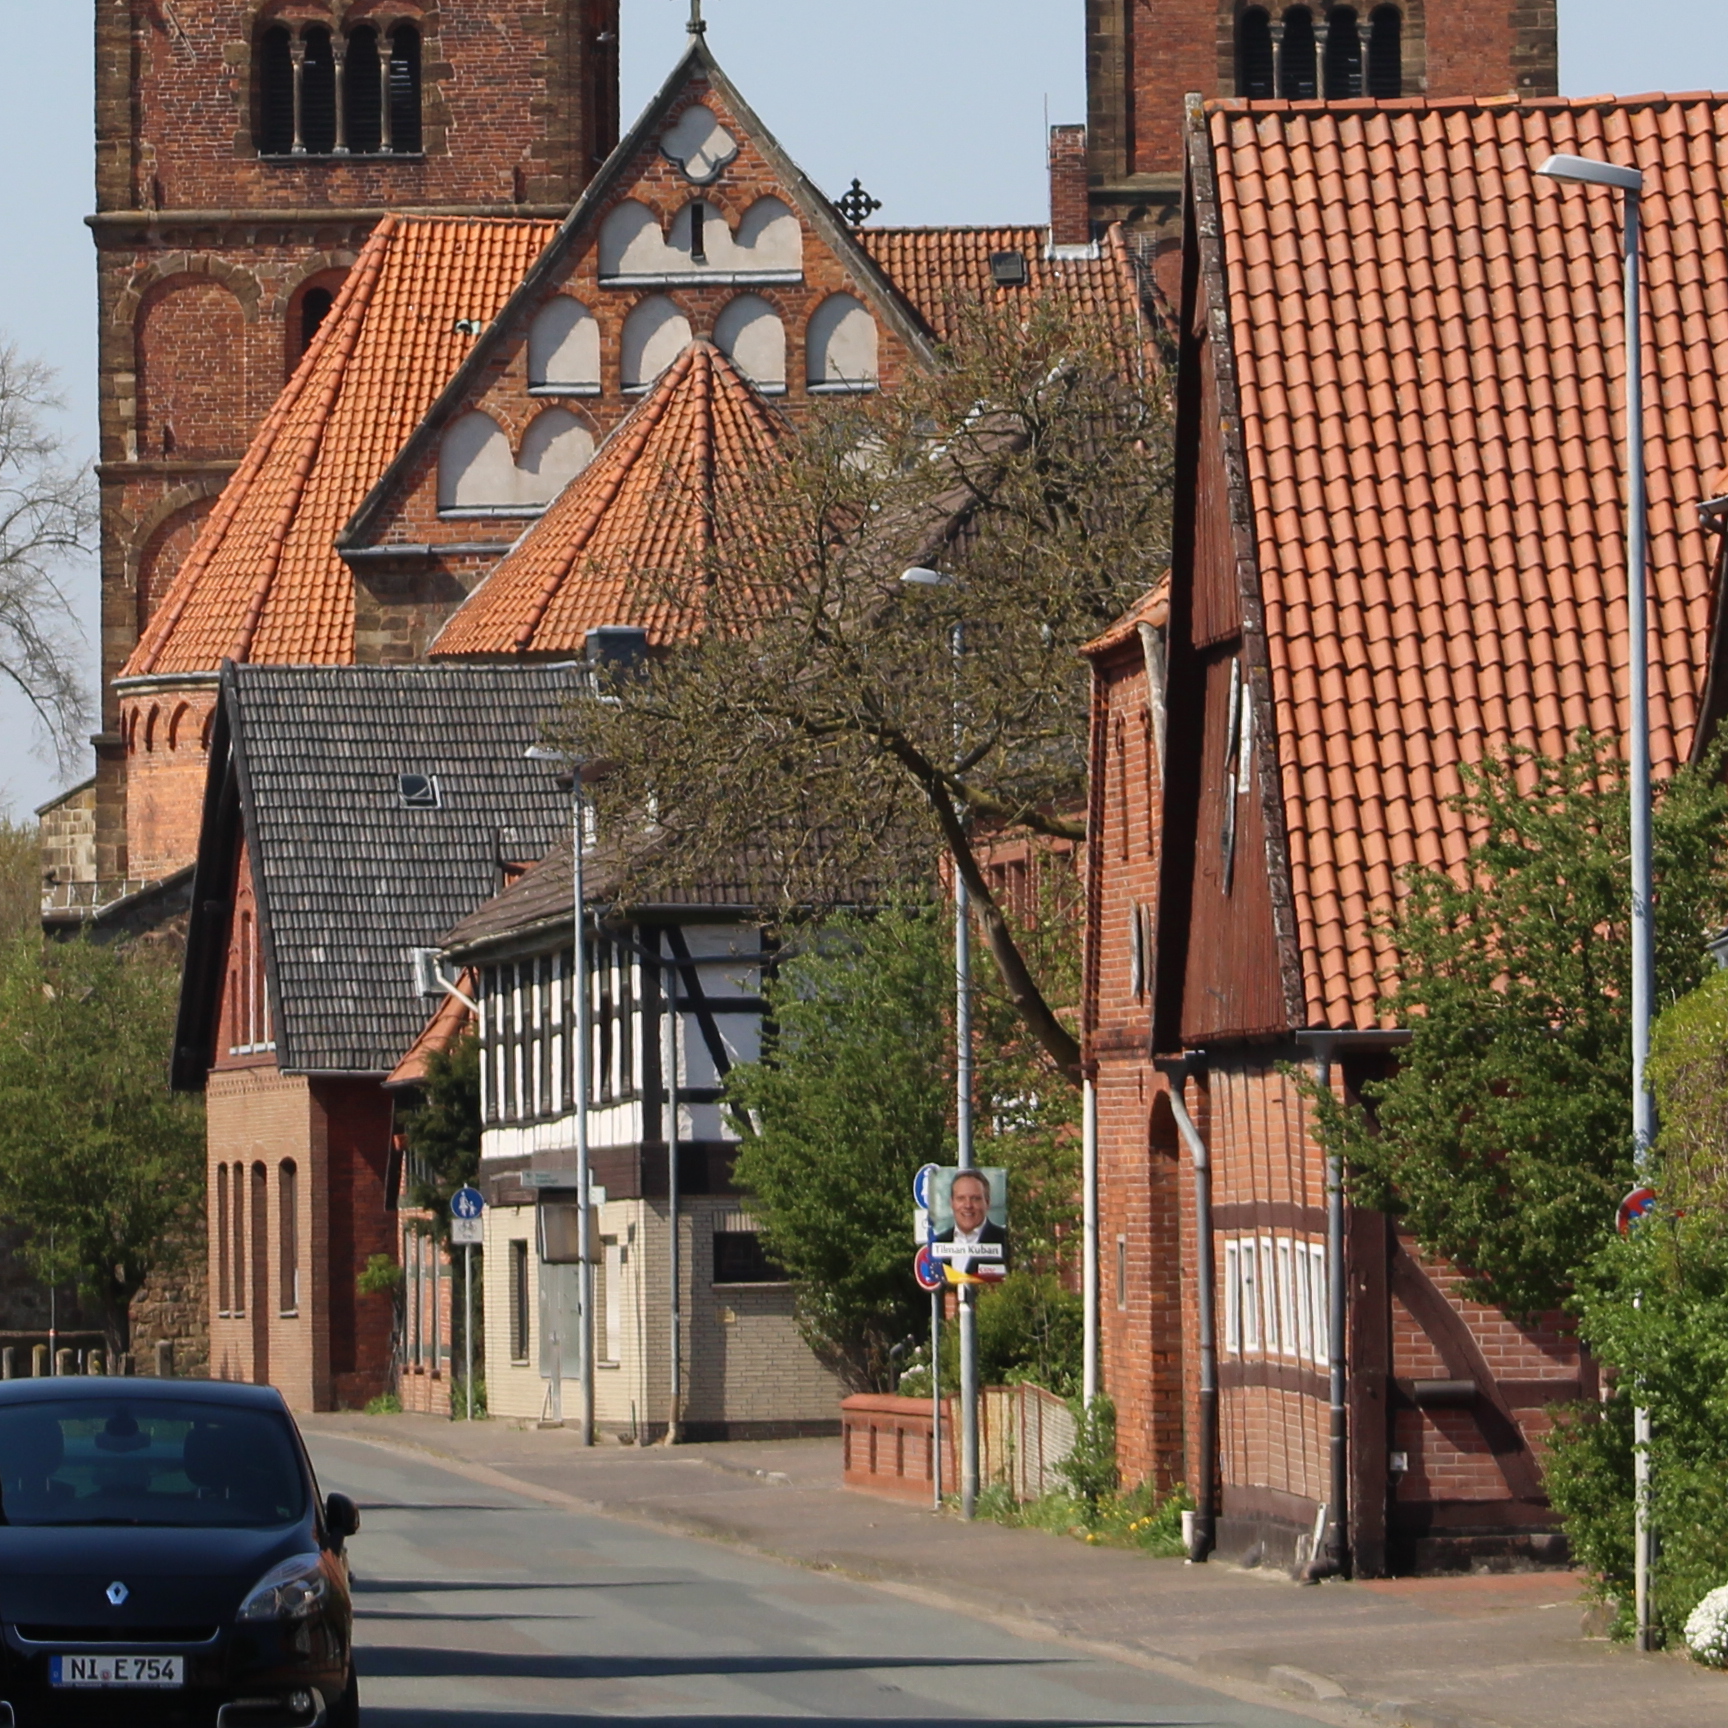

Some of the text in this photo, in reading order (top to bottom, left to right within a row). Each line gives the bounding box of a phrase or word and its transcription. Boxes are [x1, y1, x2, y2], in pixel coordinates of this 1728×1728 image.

[935, 1244, 999, 1255] Tilman Kuban
[71, 1658, 98, 1680] NI
[114, 1658, 129, 1680] E
[134, 1658, 174, 1680] 754
